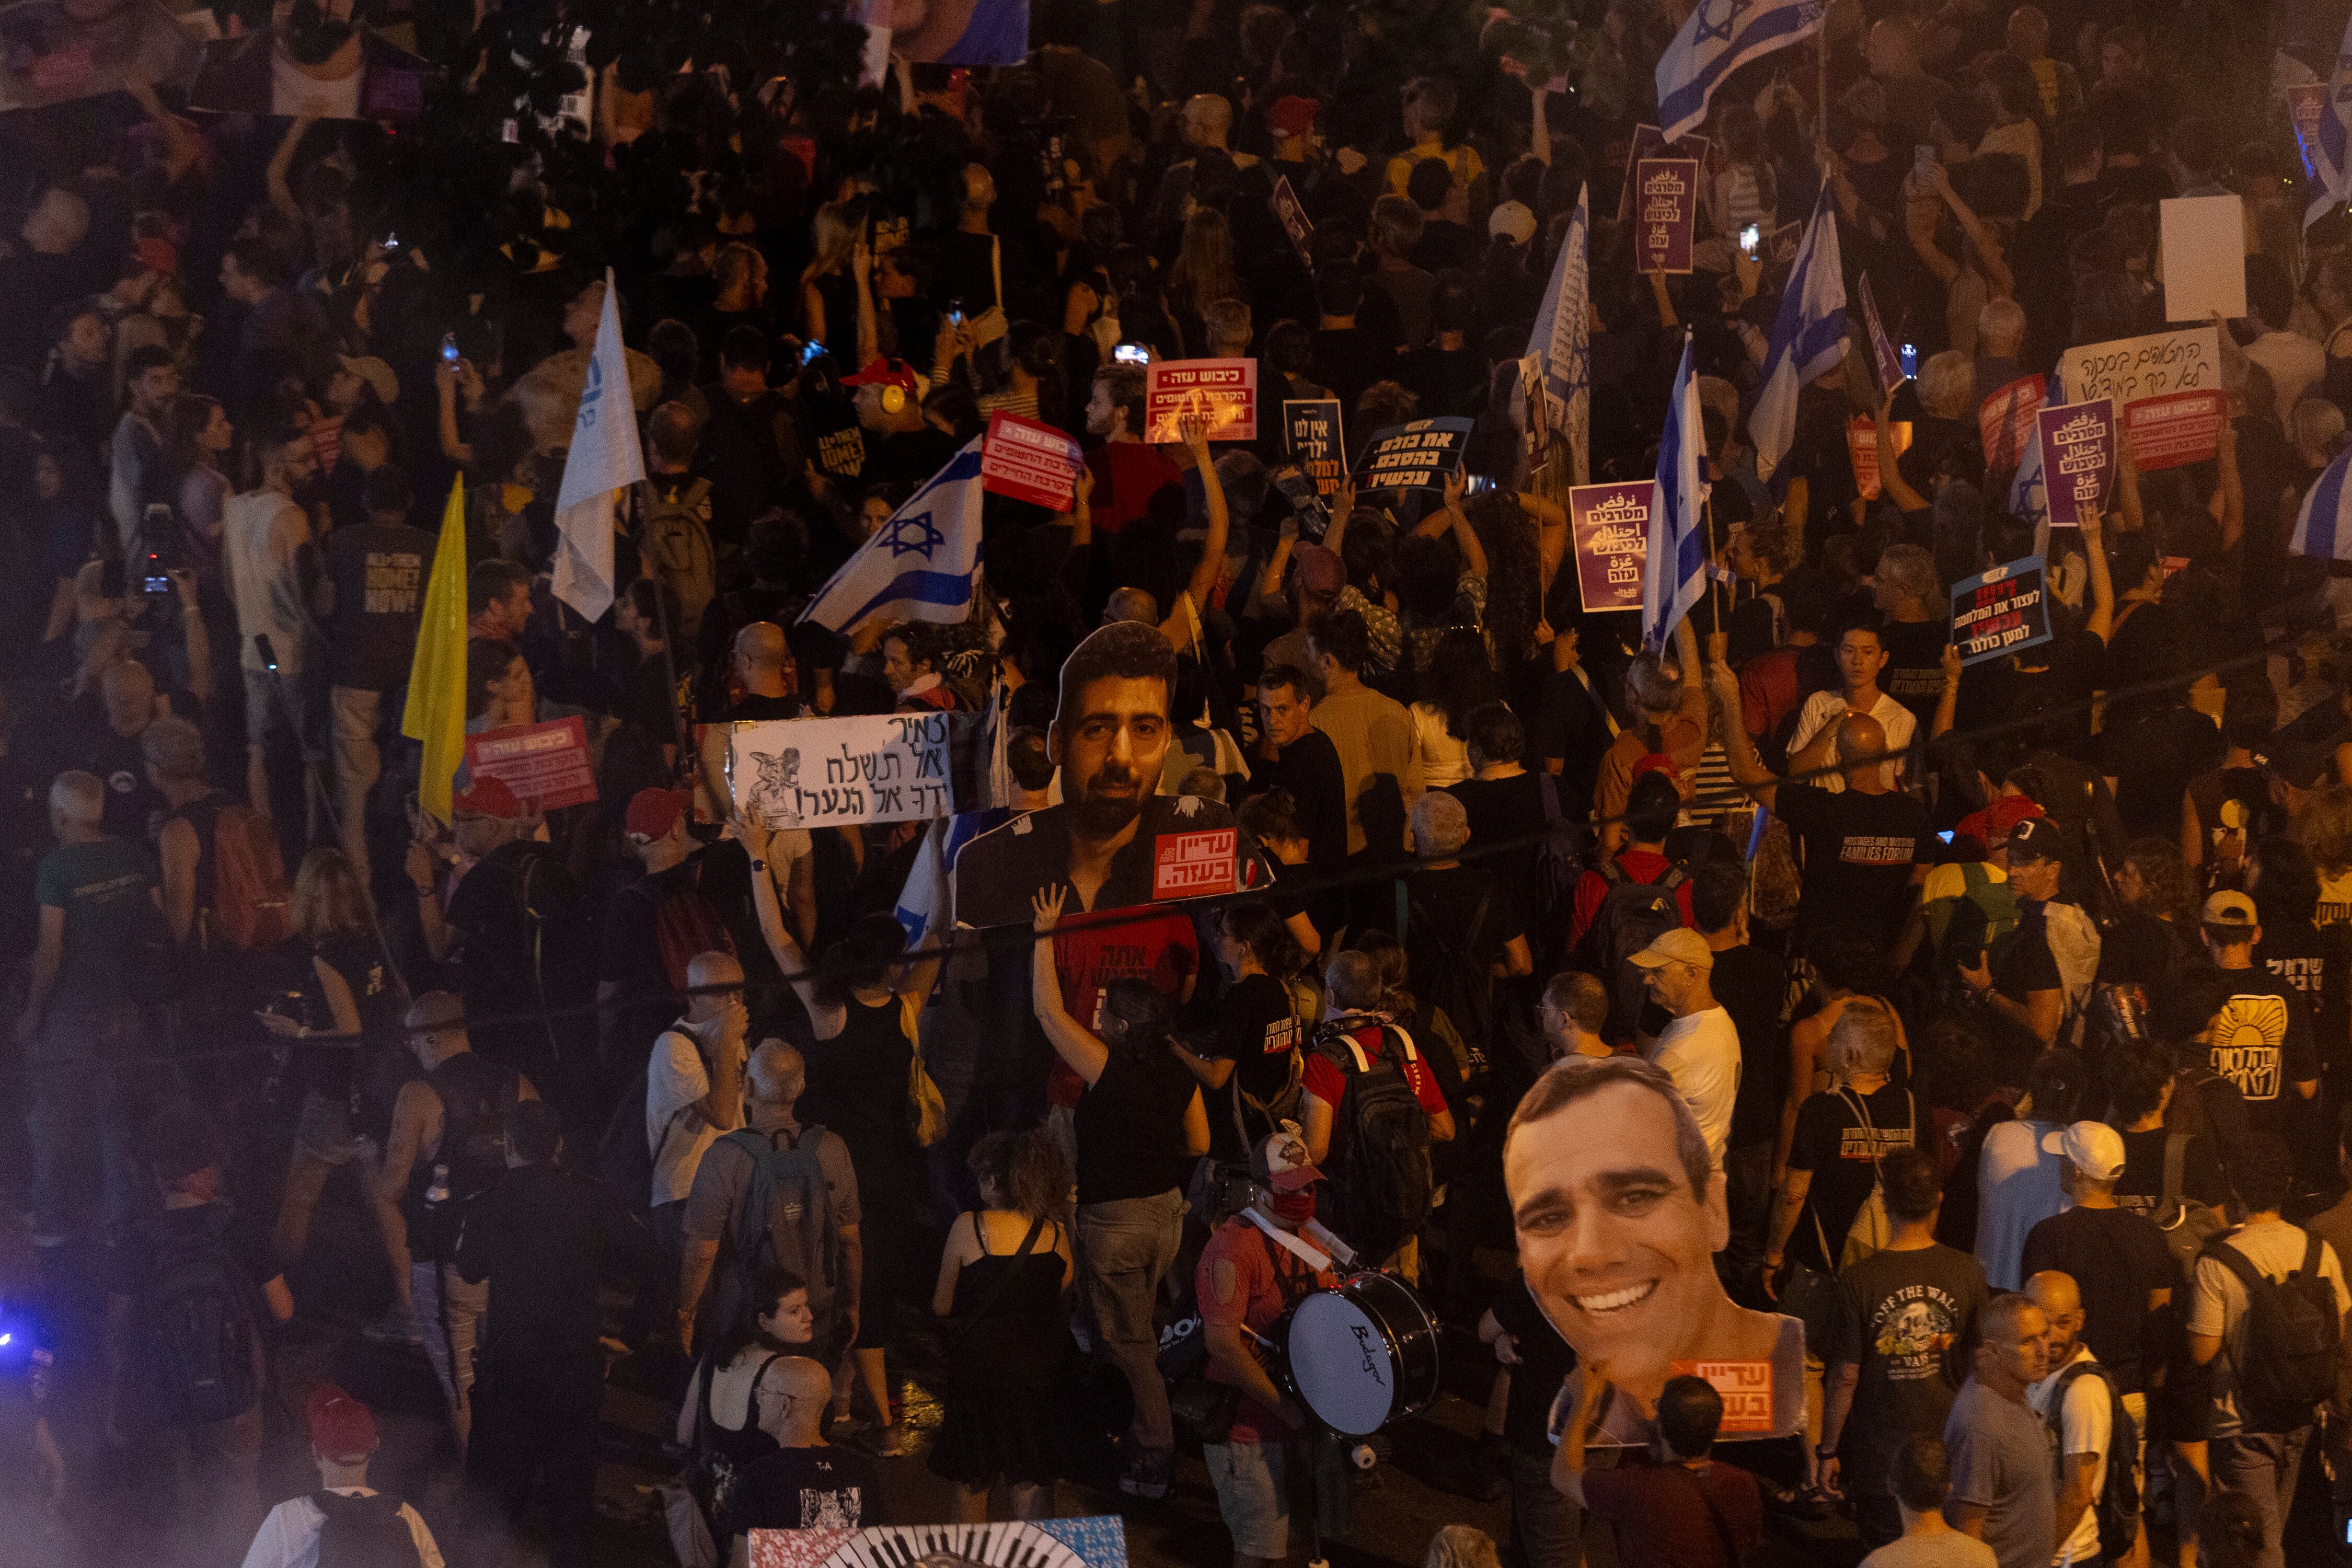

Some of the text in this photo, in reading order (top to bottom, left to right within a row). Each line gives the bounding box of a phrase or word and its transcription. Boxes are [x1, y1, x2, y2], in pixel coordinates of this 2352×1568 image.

[1646, 183, 1682, 193] מסרבים
[1170, 372, 1196, 384] עזה
[1200, 370, 1240, 383] כיבוש
[2145, 371, 2167, 395] רק
[2175, 362, 2209, 389] לא
[1310, 420, 1328, 440] אין
[2057, 424, 2104, 443] מסרבים
[1373, 432, 1454, 454] את כולם.
[1369, 450, 1440, 470] בהסכם.
[2062, 453, 2104, 471] לכיבוש
[1596, 492, 1636, 511] نرفض
[2077, 485, 2098, 498] עזה
[1590, 508, 1644, 522] מסרבים
[1597, 537, 1644, 552] לכיבוש
[1609, 554, 1633, 570] غزة
[1610, 570, 1635, 581] עזה
[1954, 590, 2040, 630] לעצור את המלחמה
[2001, 624, 2030, 647] למען
[887, 714, 947, 744] זמיר
[826, 742, 944, 784] אל תשלח
[795, 786, 865, 820] הנער!
[869, 783, 903, 813] אל
[1180, 834, 1231, 860] עדיין
[1840, 846, 1914, 861] FAMILIES FORUM
[1165, 861, 1230, 885] בעזה.
[1100, 945, 1146, 966] אתה
[1896, 1285, 1924, 1302] THE
[1350, 1325, 1387, 1387] Budagov
[1702, 1365, 1765, 1387] עדיין
